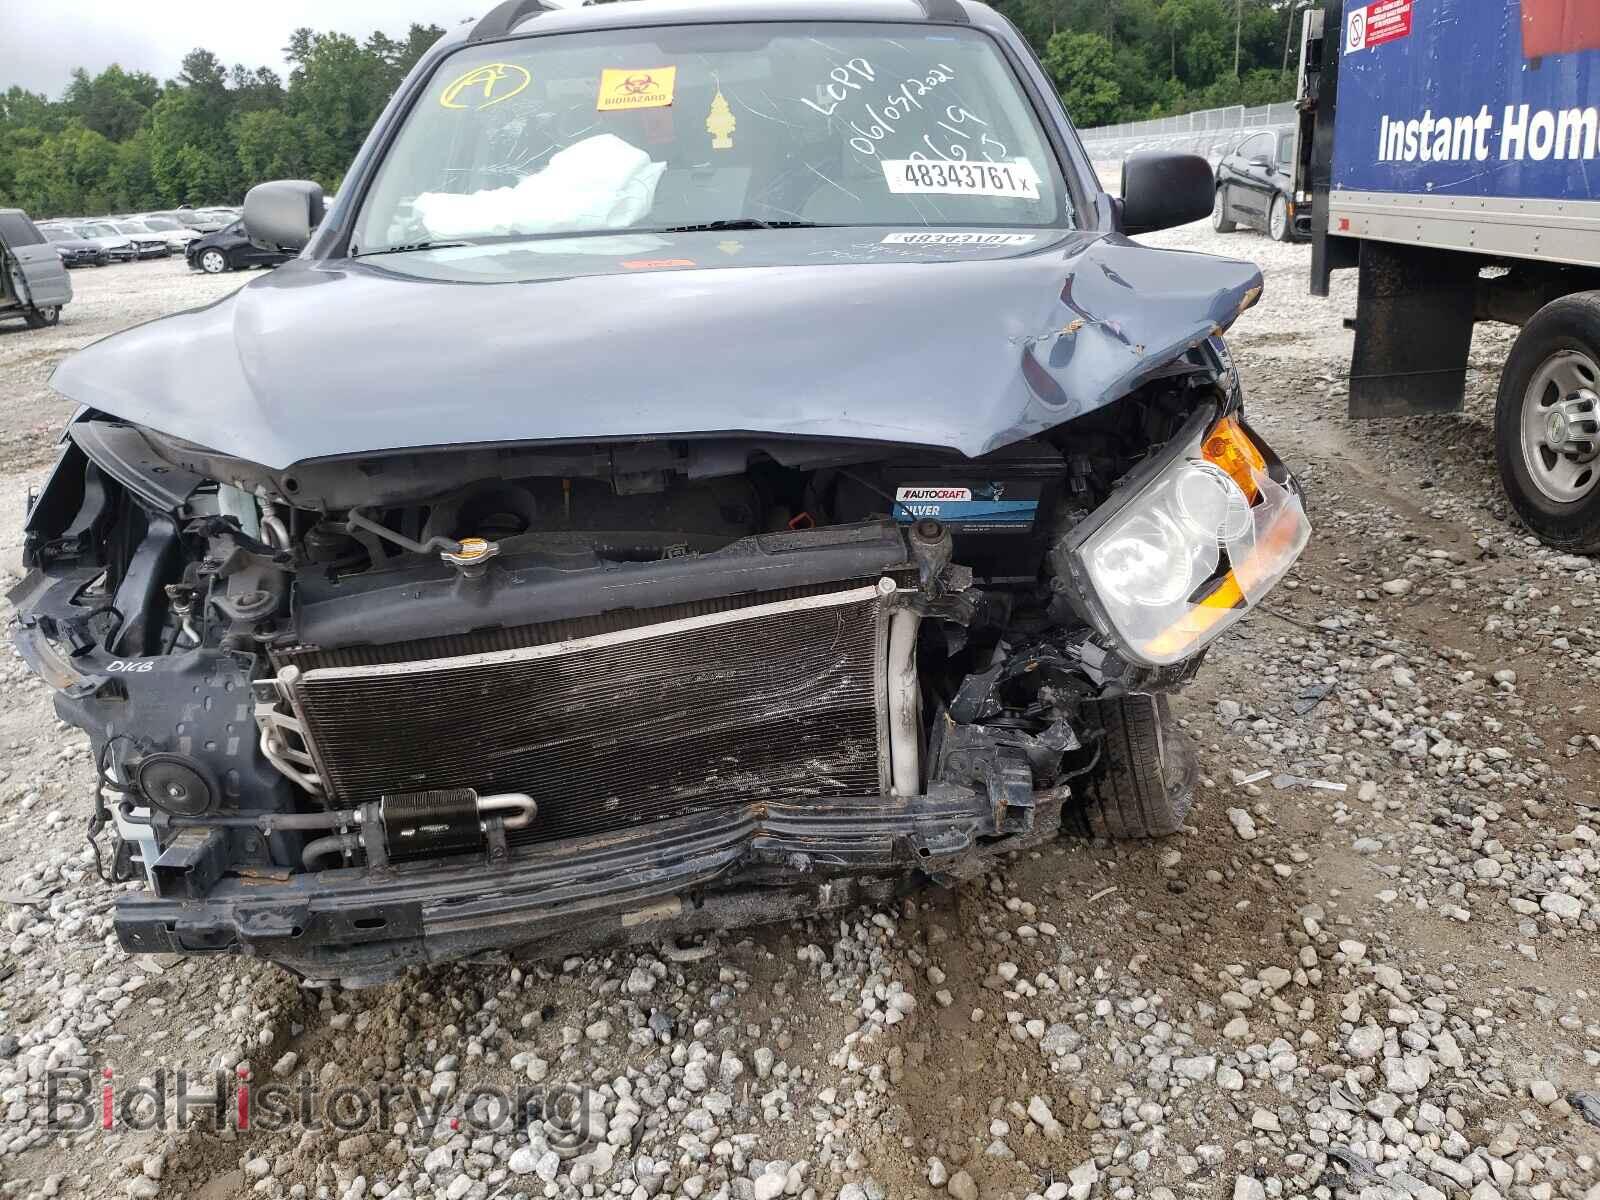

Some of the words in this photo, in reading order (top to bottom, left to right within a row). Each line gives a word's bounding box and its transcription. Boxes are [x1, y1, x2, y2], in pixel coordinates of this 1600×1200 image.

[604, 94, 666, 105] BIOHAZARD
[849, 63, 955, 155] 06/05/2021
[1378, 104, 1493, 162] Instant
[1499, 104, 1600, 161] Hom
[904, 163, 1016, 192] 48343761
[910, 489, 966, 499] AUTOCRAFT
